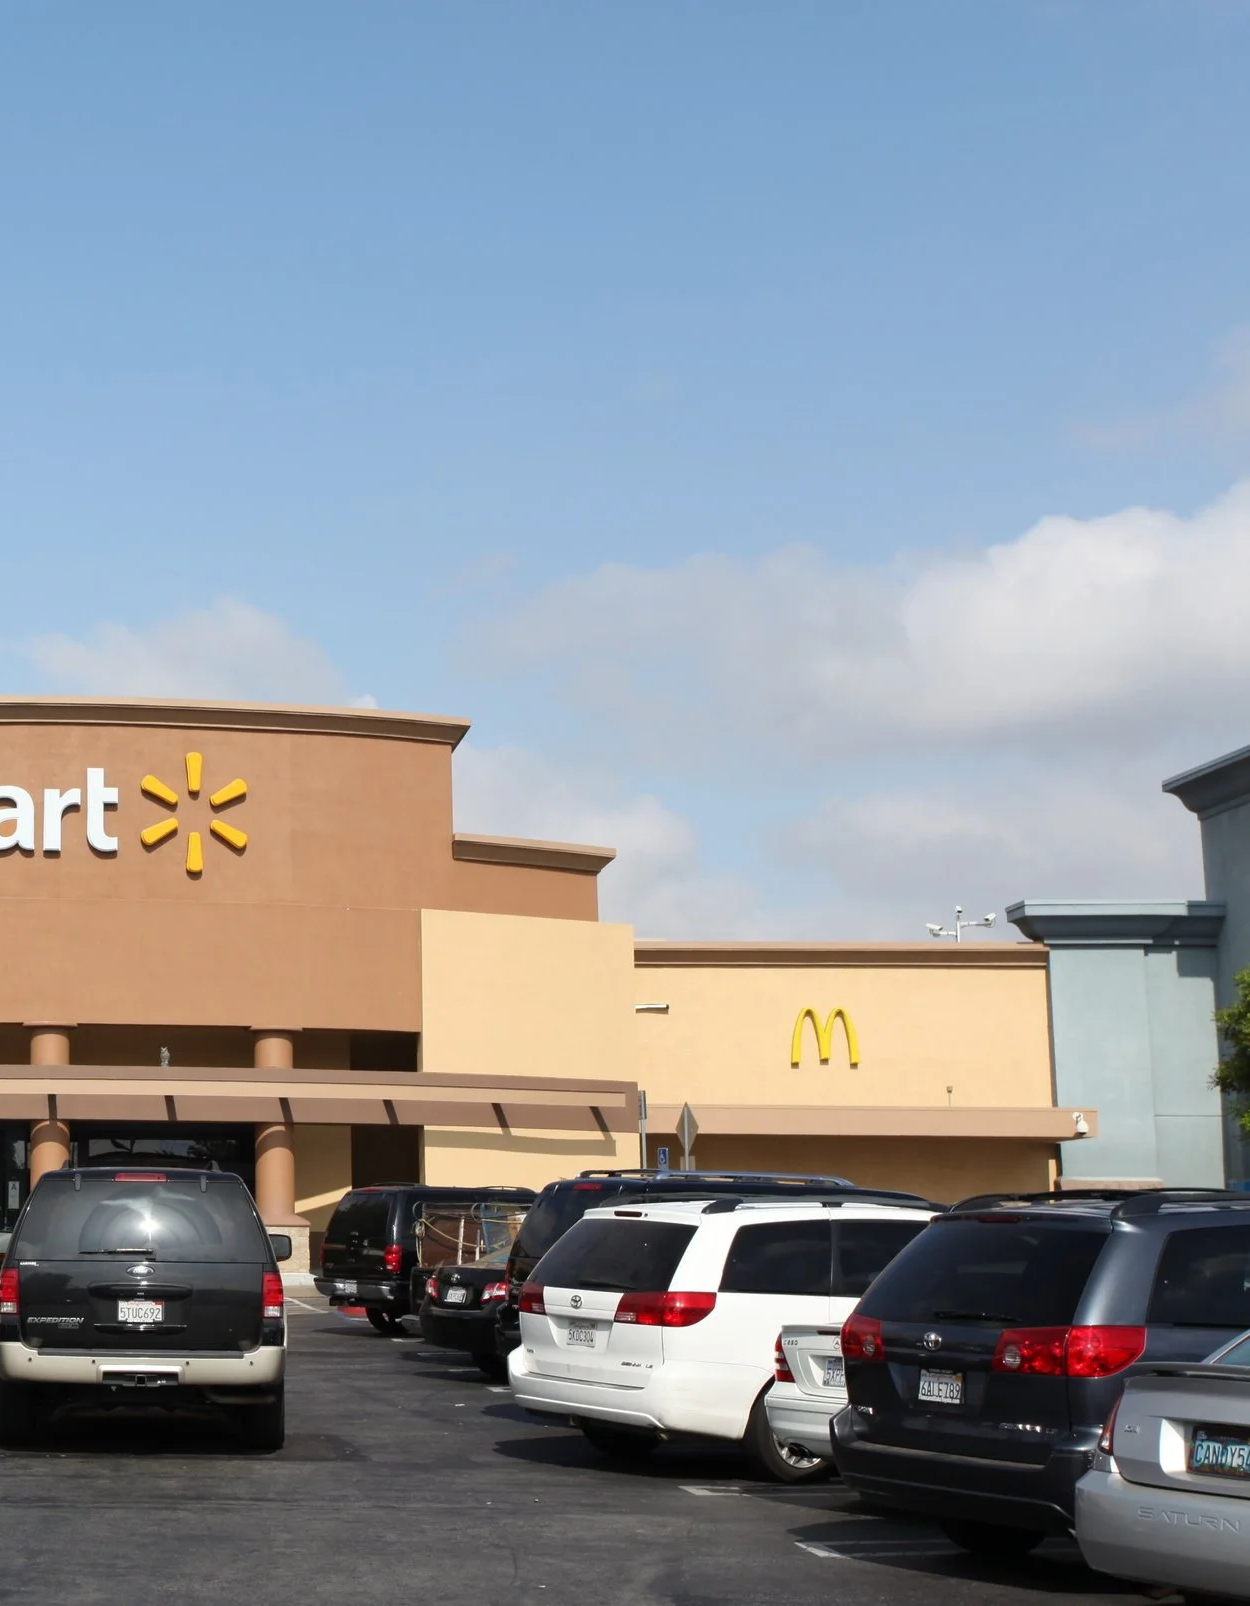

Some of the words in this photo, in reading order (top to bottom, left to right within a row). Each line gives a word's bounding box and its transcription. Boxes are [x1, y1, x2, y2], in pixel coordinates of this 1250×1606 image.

[26, 1316, 85, 1324] EXPEDITION
[120, 1307, 162, 1320] 5TUC692
[920, 1381, 961, 1399] 6ALE789
[1137, 1505, 1242, 1534] SATURN
